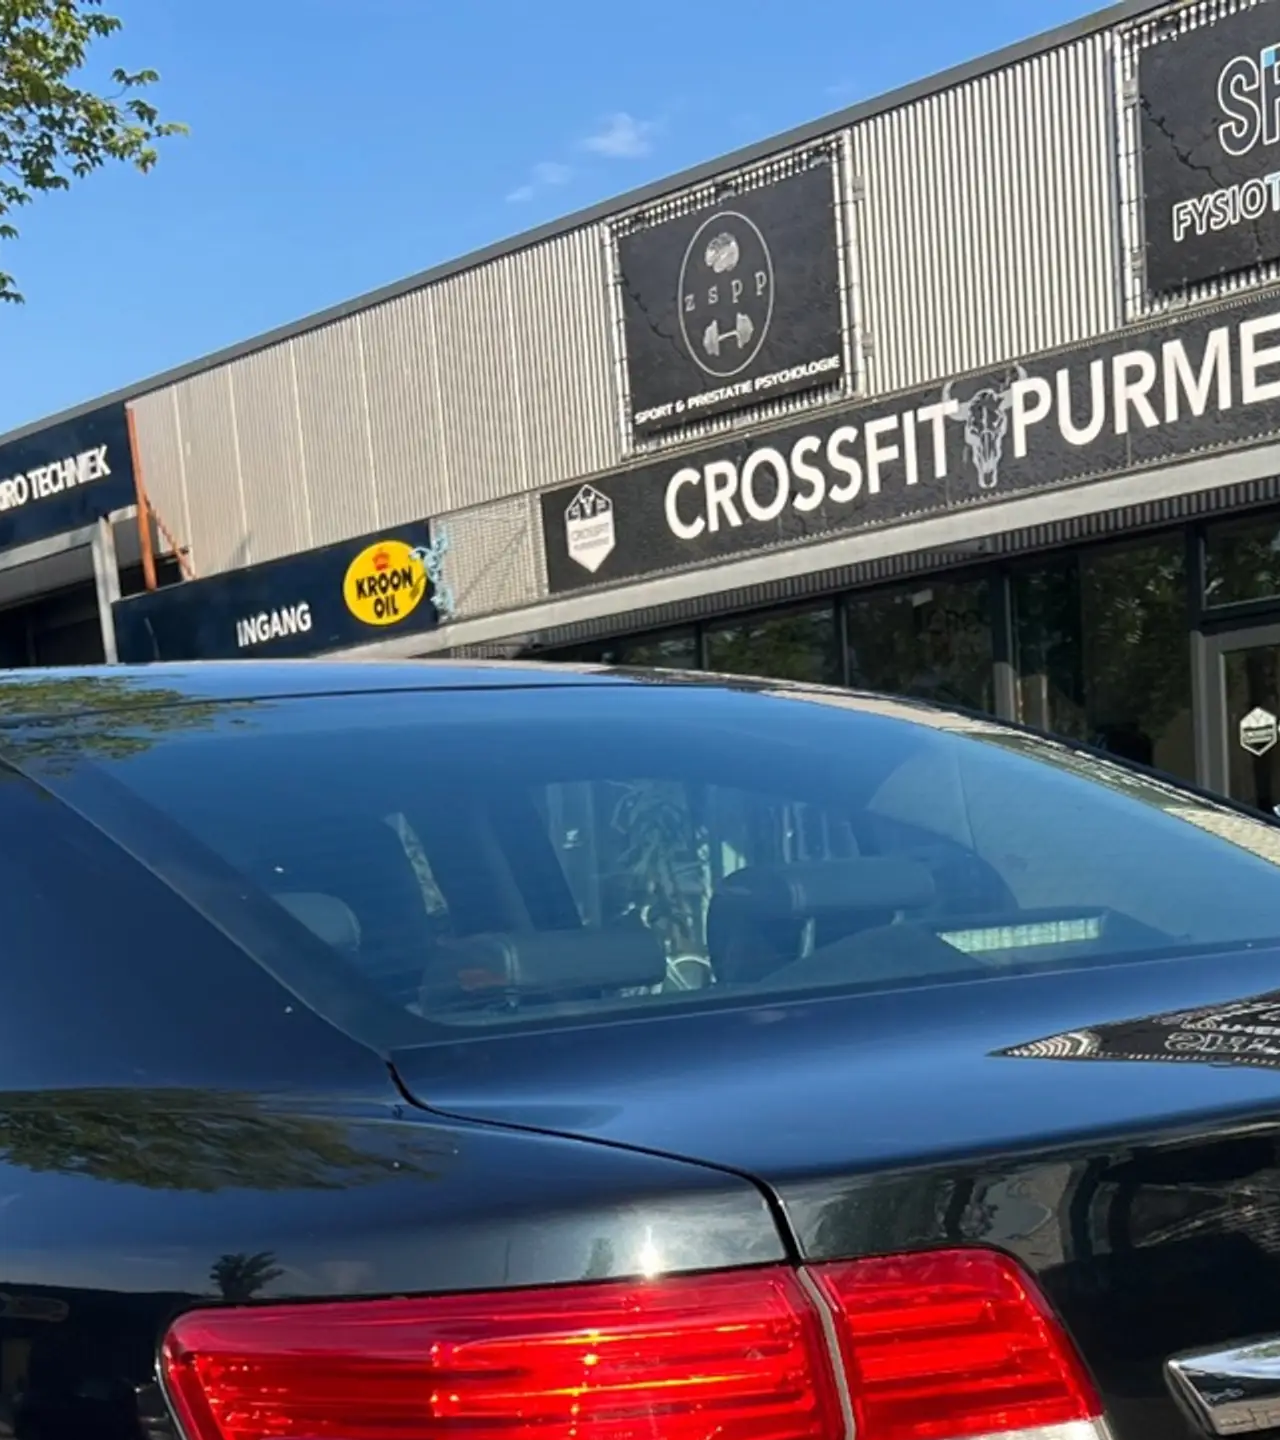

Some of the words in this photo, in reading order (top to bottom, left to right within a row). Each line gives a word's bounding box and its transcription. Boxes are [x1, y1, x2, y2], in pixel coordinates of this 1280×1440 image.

[634, 403, 674, 425] SPORT
[26, 444, 111, 499] TECHNIEK
[665, 400, 960, 541] CROSSFIT
[356, 566, 413, 600] KROON
[236, 601, 312, 647] INGANG
[373, 596, 400, 619] OIL
